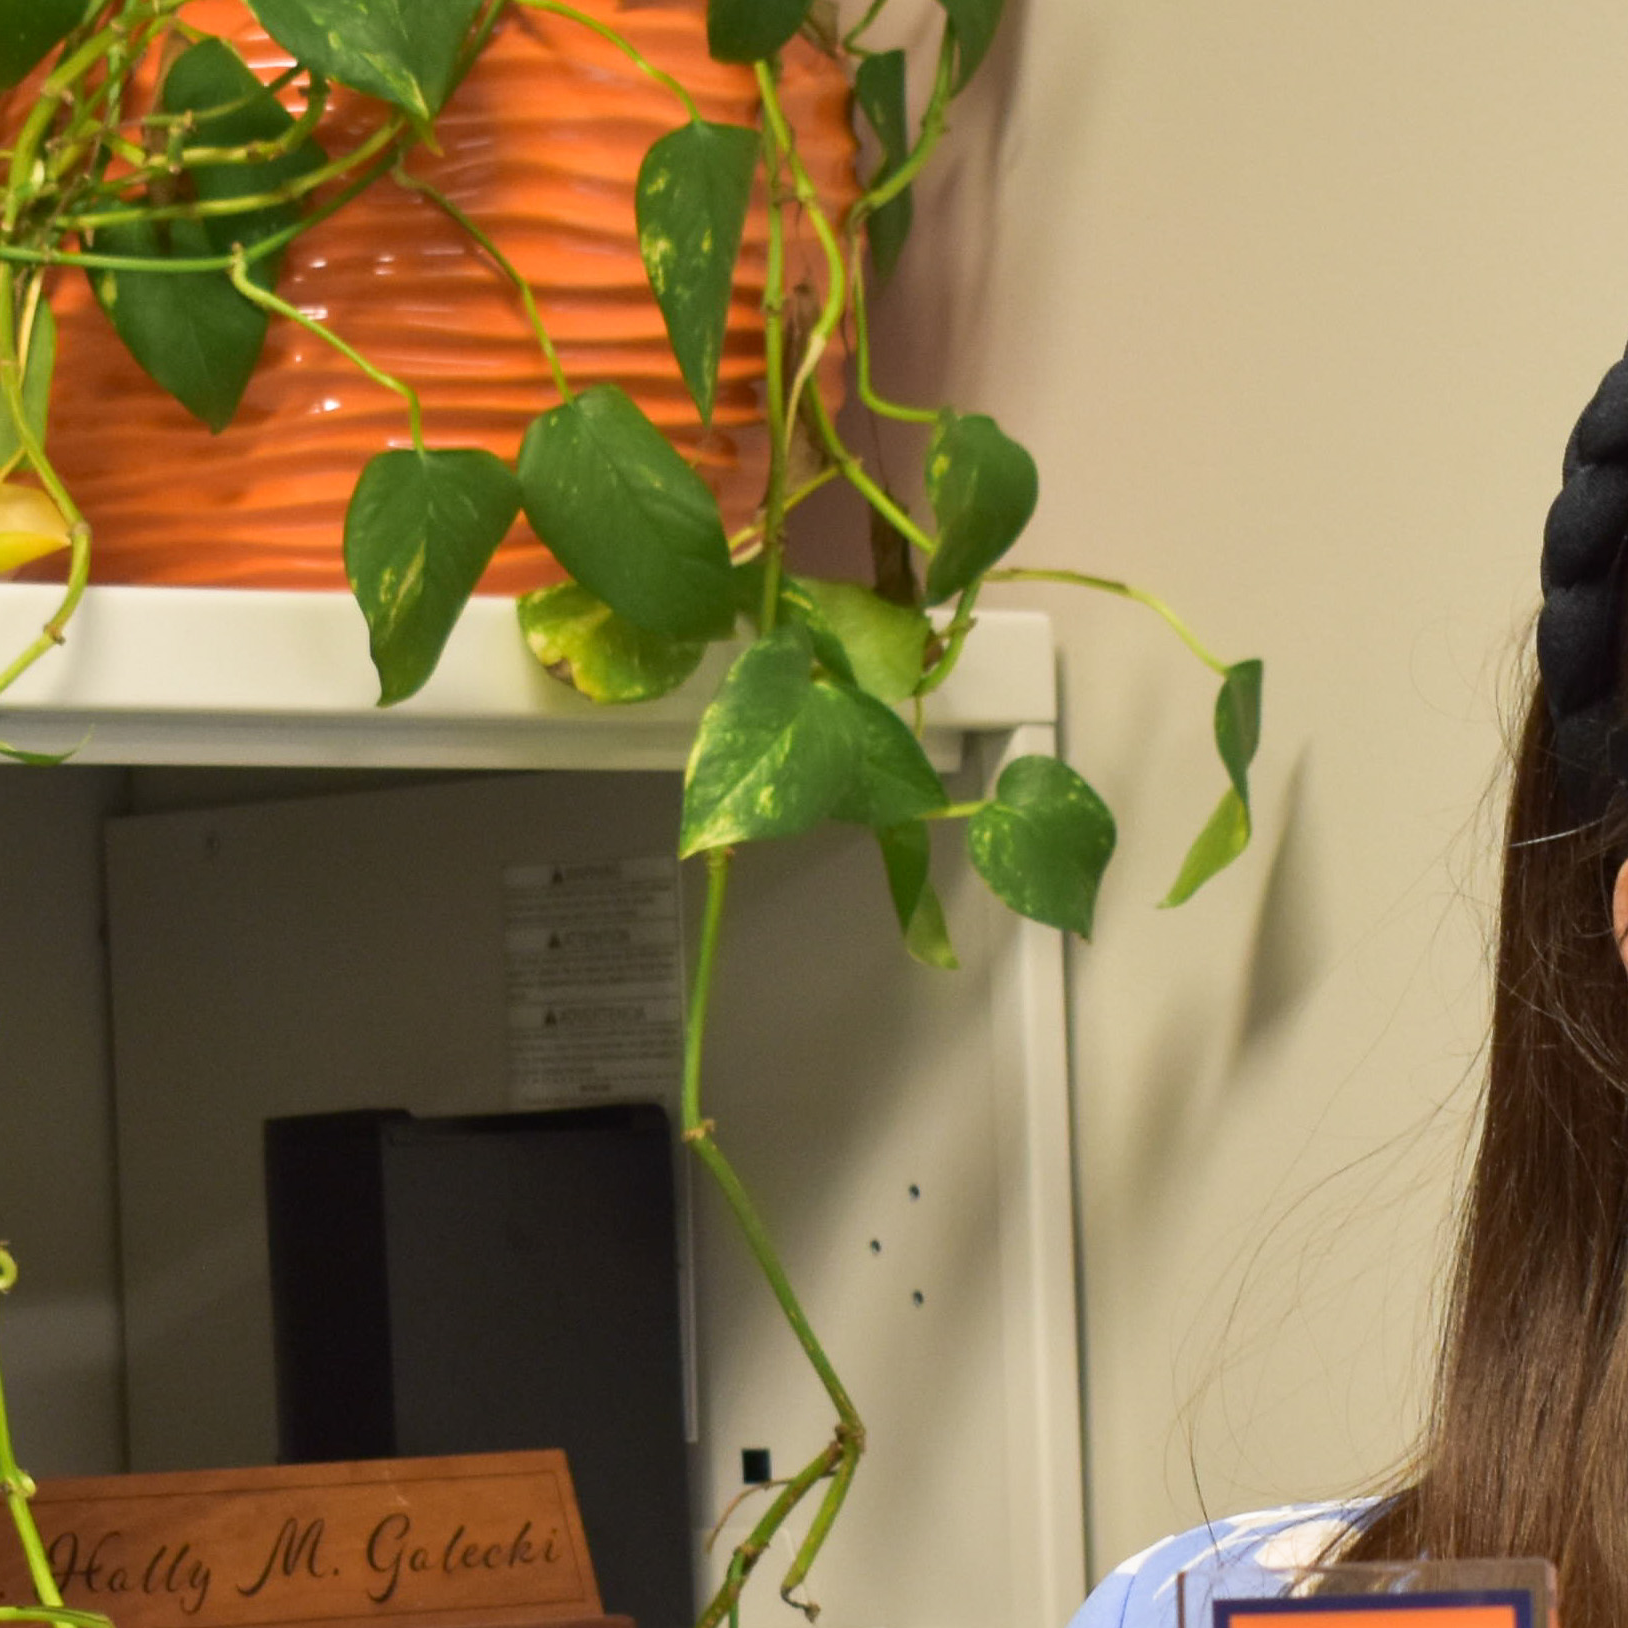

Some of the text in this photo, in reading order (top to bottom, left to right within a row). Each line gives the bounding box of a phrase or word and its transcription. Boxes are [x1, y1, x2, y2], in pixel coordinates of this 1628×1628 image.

[47, 1530, 212, 1615] Holly
[237, 1518, 339, 1597] M.
[365, 1513, 562, 1602] Golecki
